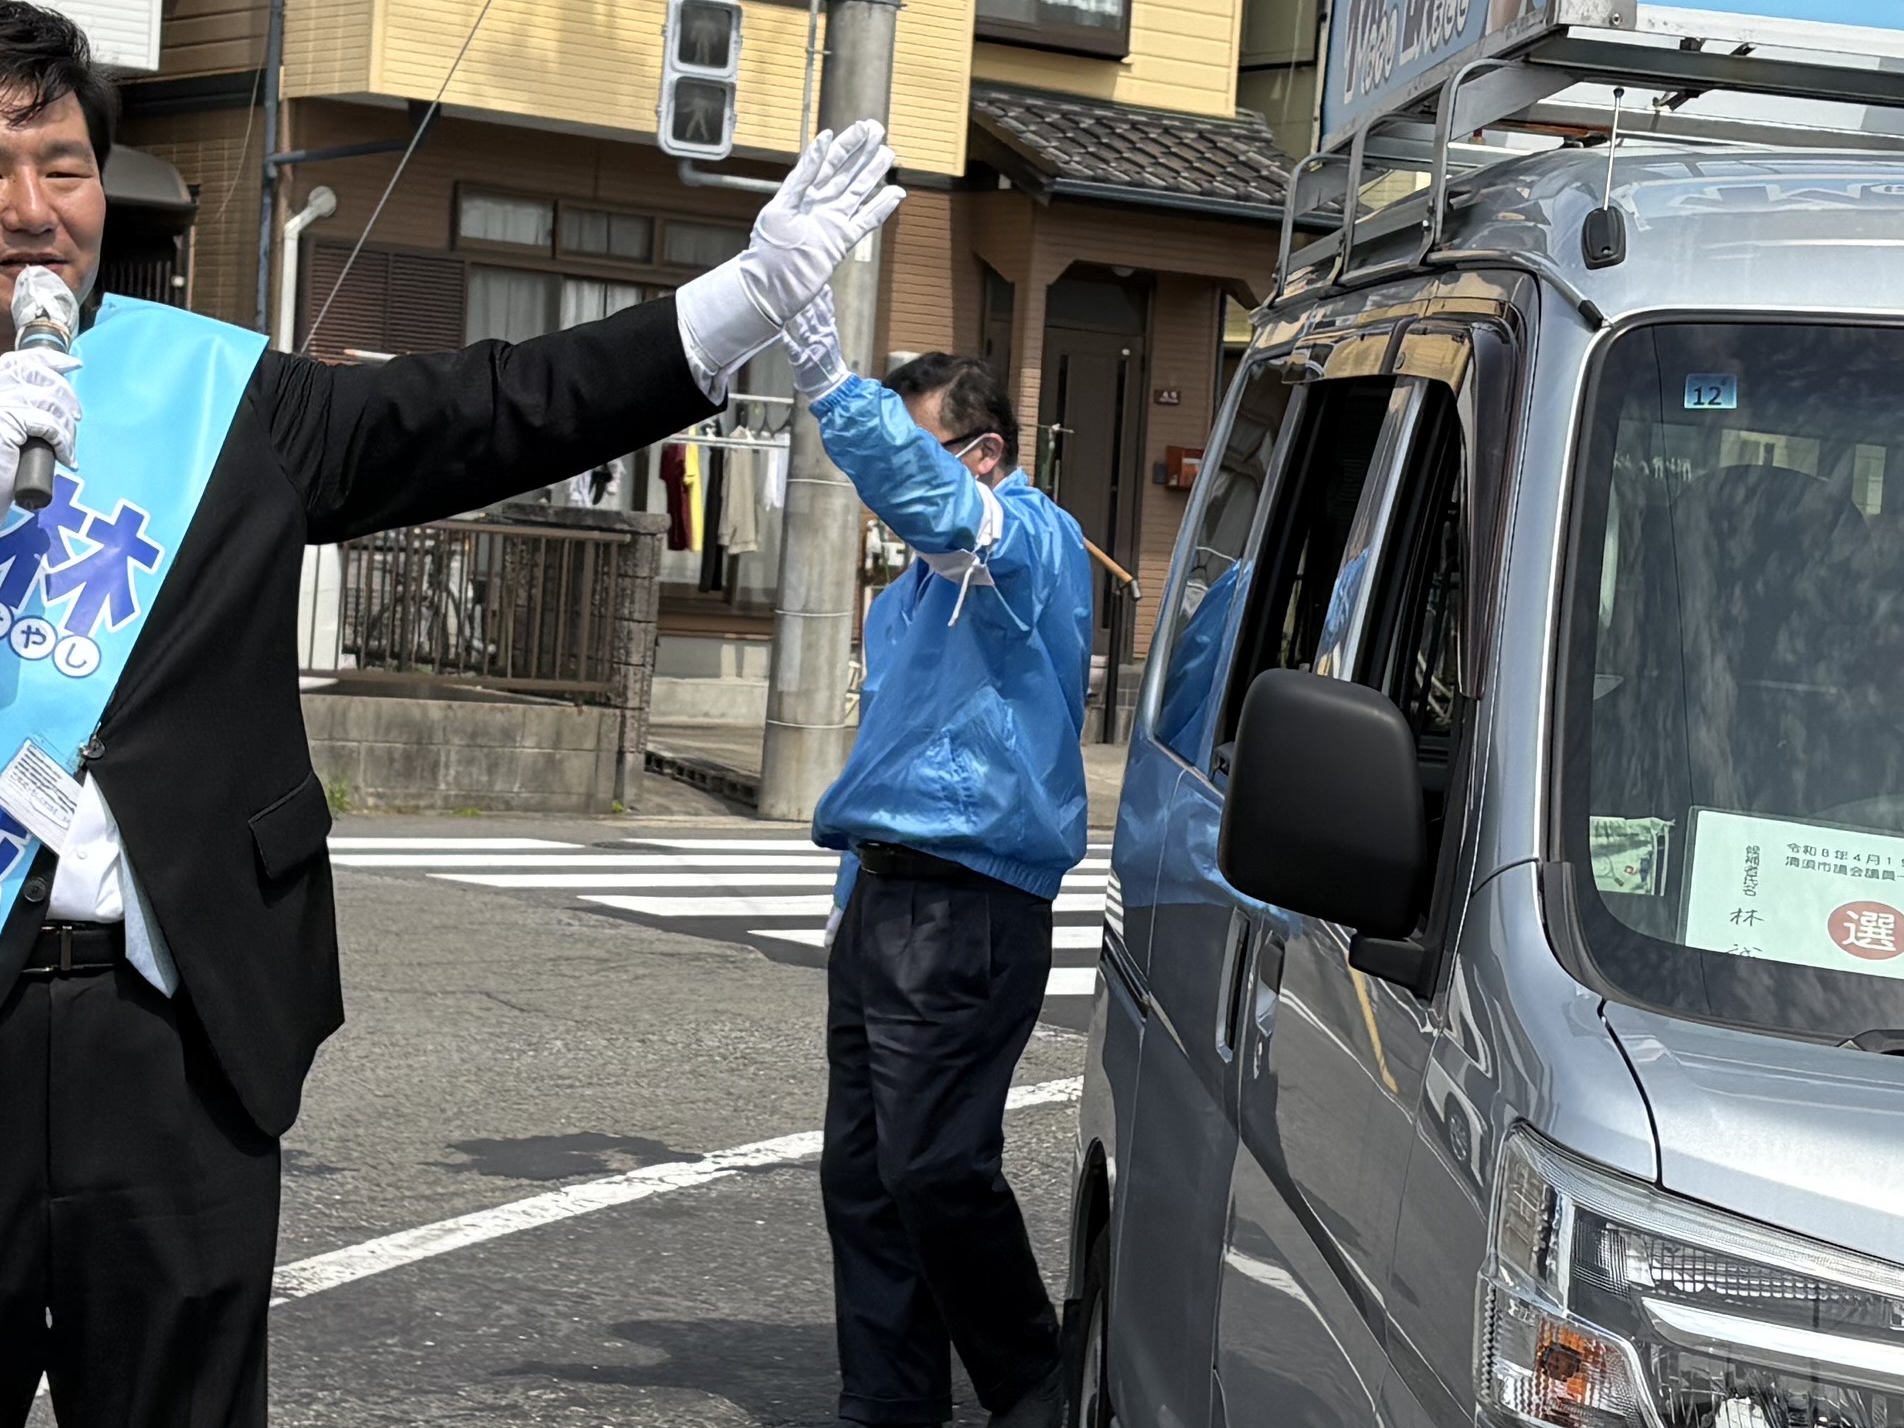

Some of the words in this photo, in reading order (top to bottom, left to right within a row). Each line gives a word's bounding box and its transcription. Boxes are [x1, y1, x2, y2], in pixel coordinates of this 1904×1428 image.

[1692, 385, 1722, 406] 12
[1729, 907, 1766, 927] 林
[1841, 909, 1897, 952] 選
